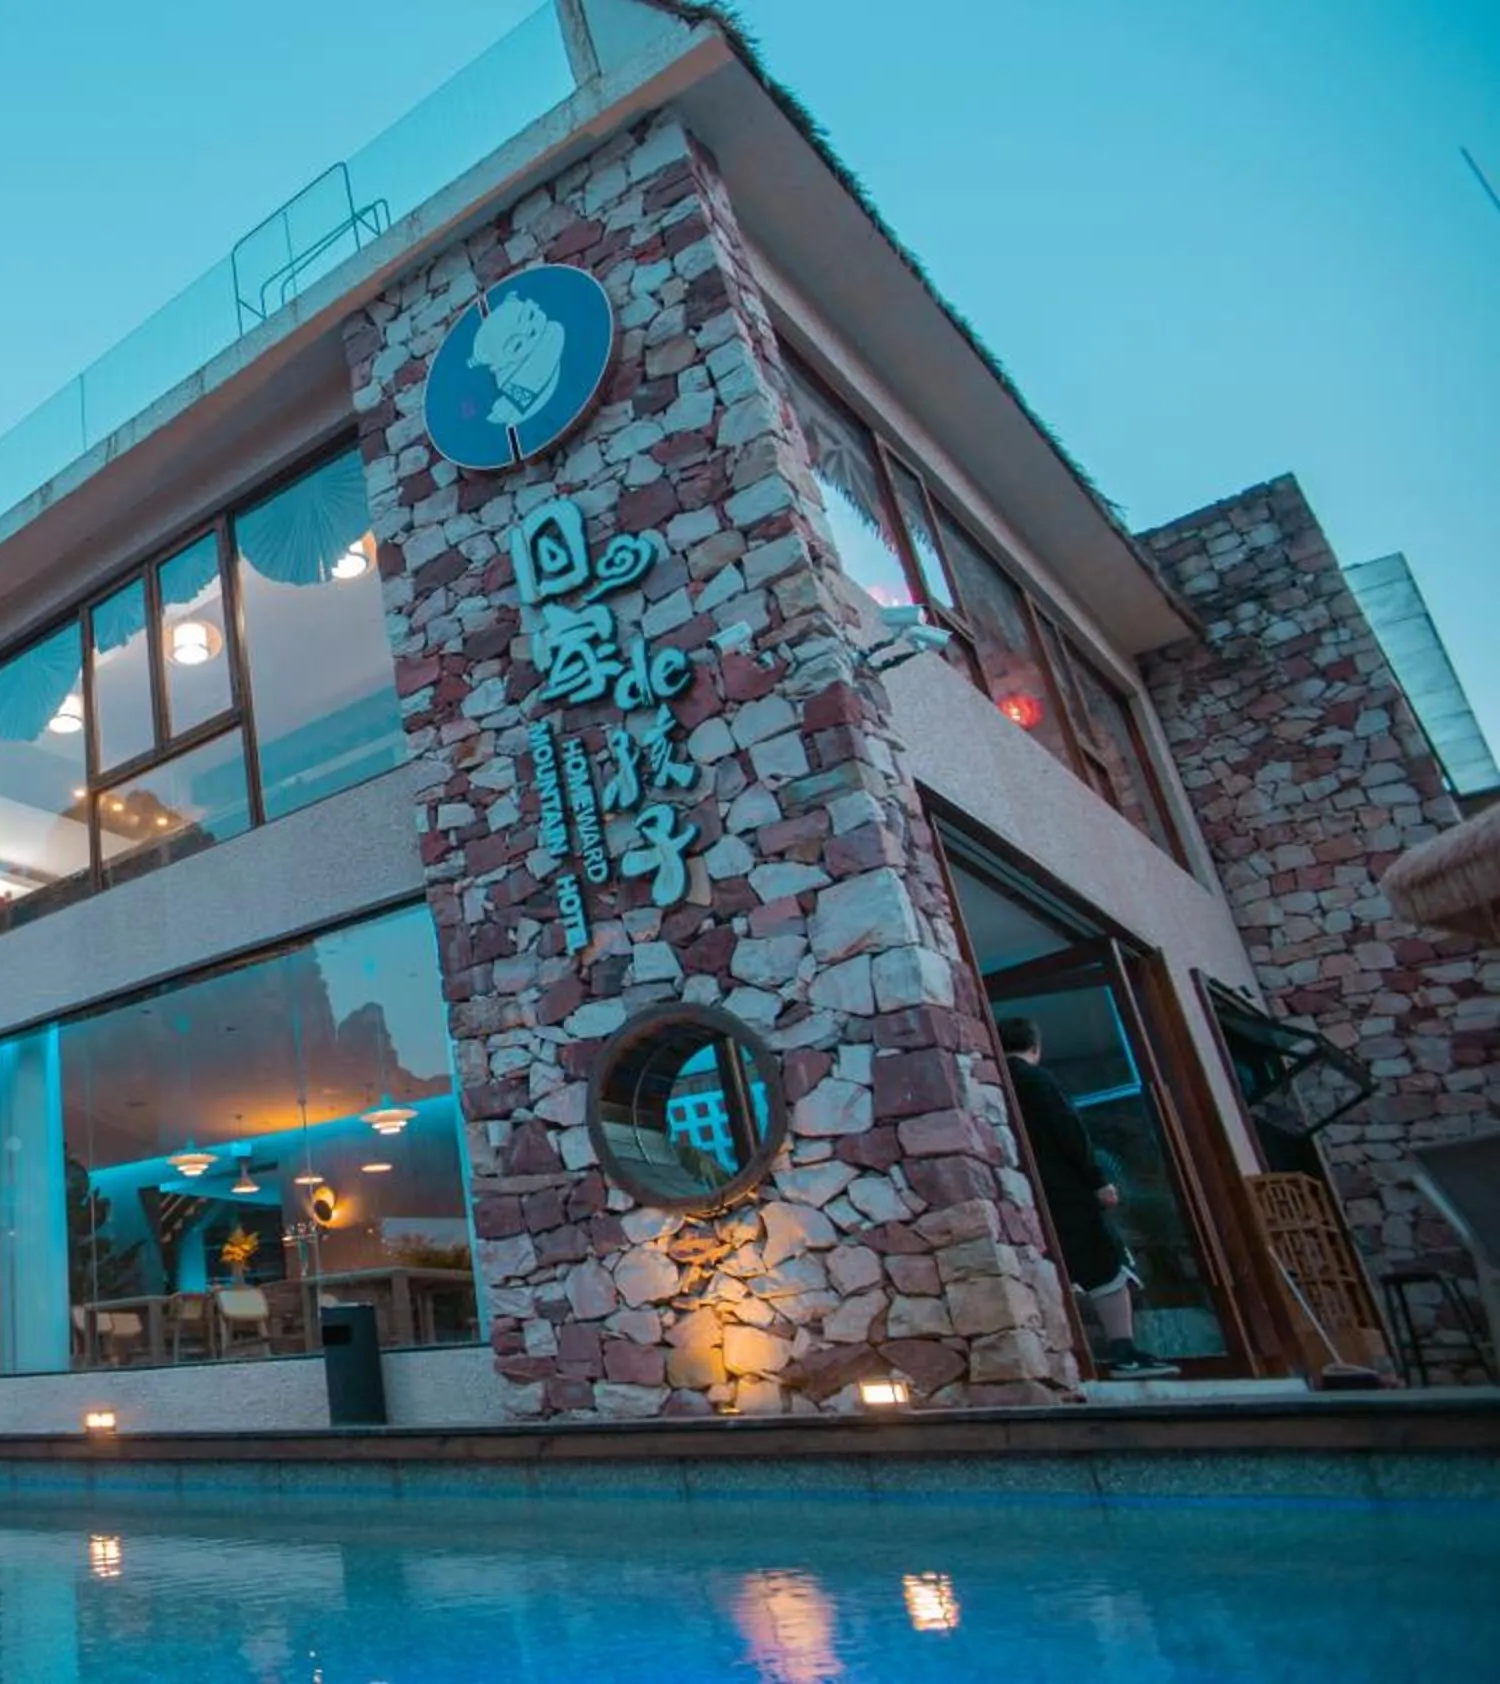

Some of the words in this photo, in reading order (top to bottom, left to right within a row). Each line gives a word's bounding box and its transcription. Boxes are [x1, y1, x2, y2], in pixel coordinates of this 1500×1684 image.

[528, 720, 568, 856] MOUNTAIN
[556, 874, 589, 956] HOTEL
[564, 738, 608, 884] HOMEWARD
